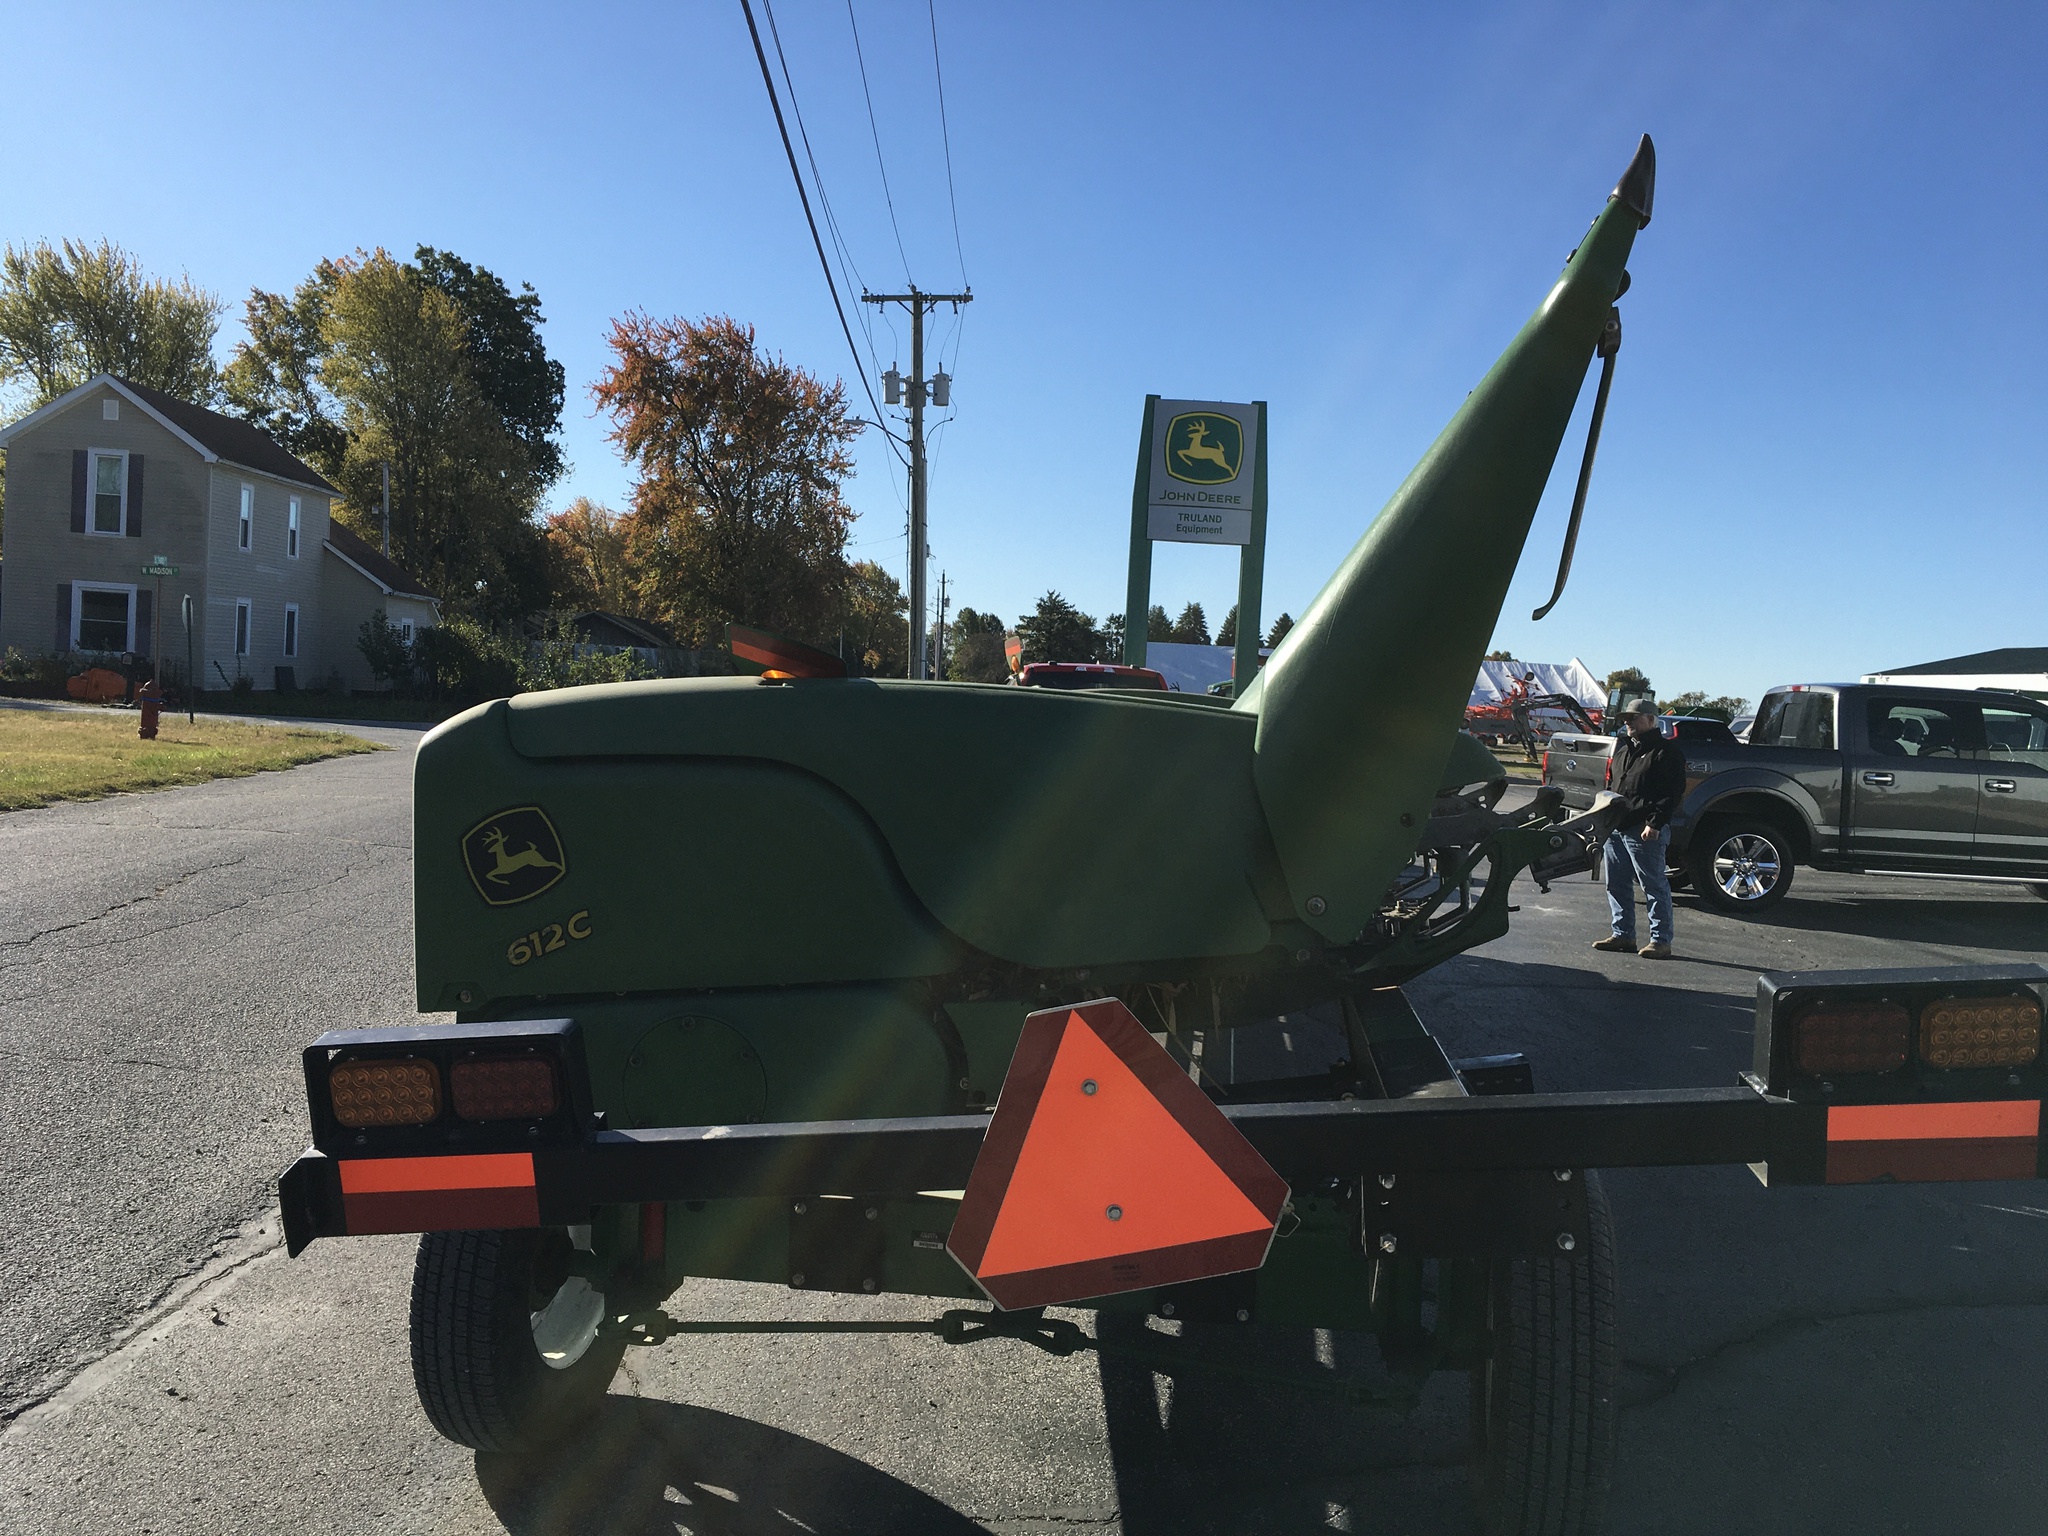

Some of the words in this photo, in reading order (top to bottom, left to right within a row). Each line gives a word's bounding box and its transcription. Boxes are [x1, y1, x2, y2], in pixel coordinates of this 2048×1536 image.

[1159, 490, 1195, 502] JOHN
[1197, 491, 1241, 504] DEERE
[1178, 512, 1222, 524] TRULAND
[1176, 523, 1222, 535] Equipment
[149, 567, 173, 576] MADISON
[506, 909, 593, 967] 612C
